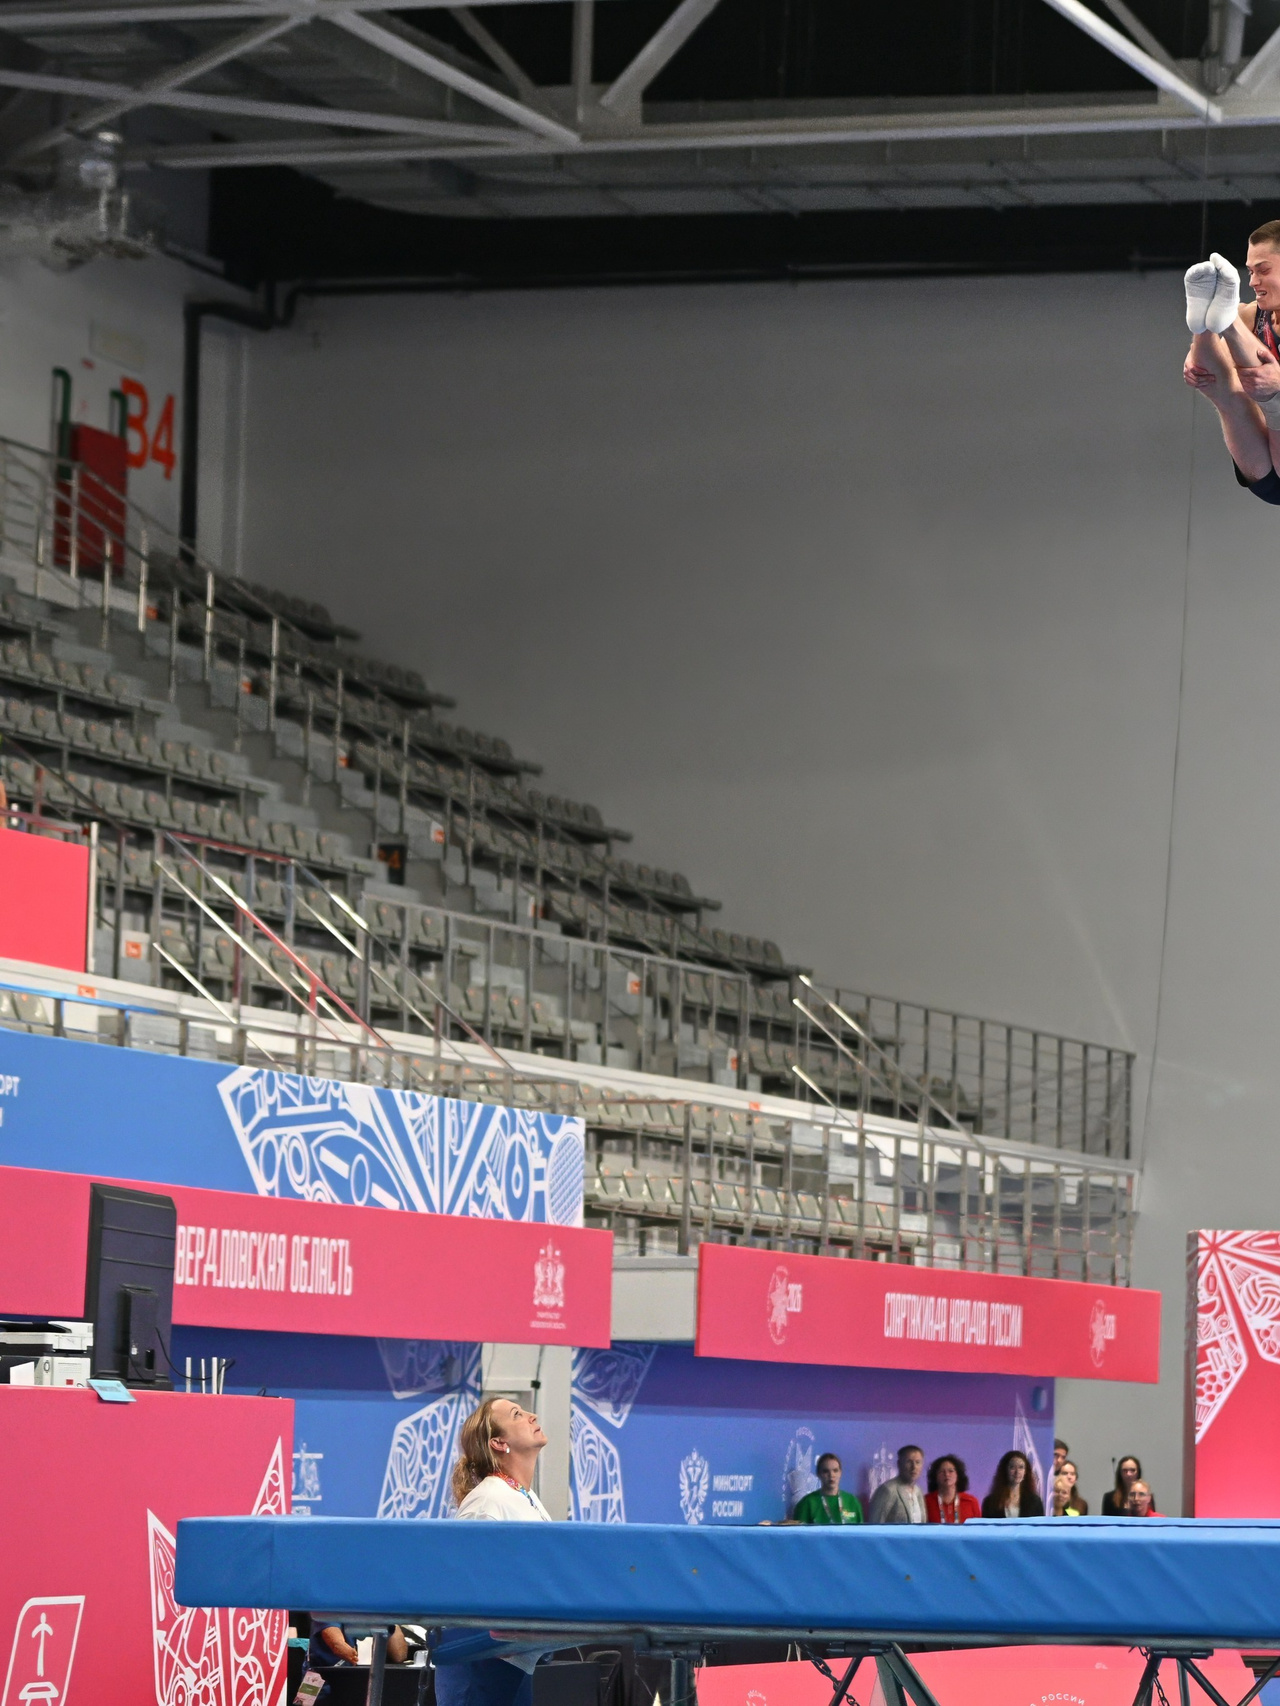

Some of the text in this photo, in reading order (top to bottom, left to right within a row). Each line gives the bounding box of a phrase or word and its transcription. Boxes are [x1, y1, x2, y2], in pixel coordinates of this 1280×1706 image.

[175, 1225, 353, 1296] ВЕРДЛОВСКАЯ ОБЛАСТЬ
[988, 1302, 1023, 1347] РОССИИ
[712, 1474, 754, 1492] МИНСПОРТ
[712, 1501, 744, 1517] РОССИИ
[1041, 1693, 1085, 1706] РОССИИ
